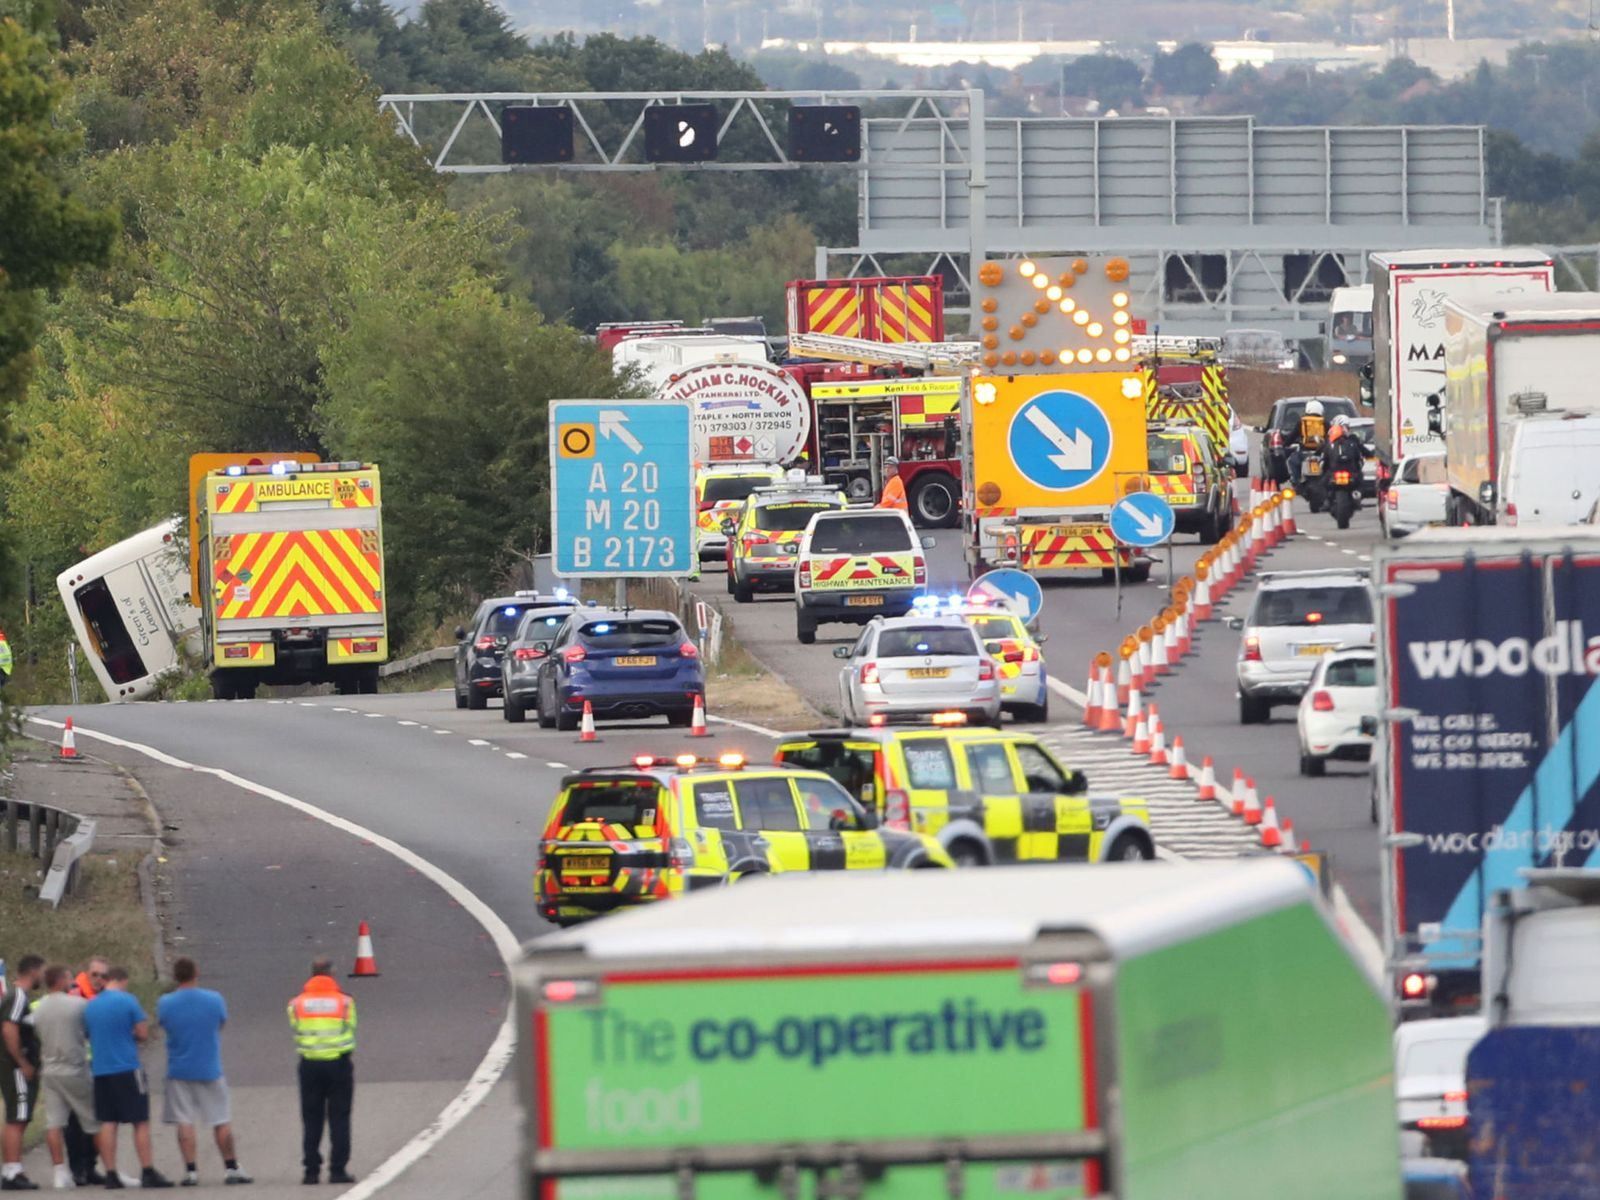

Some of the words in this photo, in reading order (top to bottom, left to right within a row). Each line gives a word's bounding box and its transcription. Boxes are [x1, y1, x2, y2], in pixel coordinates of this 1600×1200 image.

[884, 385, 904, 393] Kent
[710, 423, 747, 432] 379303
[756, 421, 791, 430] 372945
[588, 462, 608, 493] A
[621, 462, 658, 493] 20
[258, 482, 330, 497] AMBULANCE
[585, 499, 611, 530] M
[623, 499, 660, 530] 20
[573, 536, 592, 567] B
[604, 536, 675, 568] 2173
[813, 580, 849, 588] HIGHWAY
[853, 577, 912, 587] MAINTENANCE
[139, 596, 159, 635] London
[1411, 715, 1441, 731] WE
[1411, 734, 1442, 750] WE
[1411, 753, 1442, 769] WE
[583, 1007, 677, 1067] The
[688, 999, 1047, 1067] co-operative
[585, 1075, 702, 1136] food
